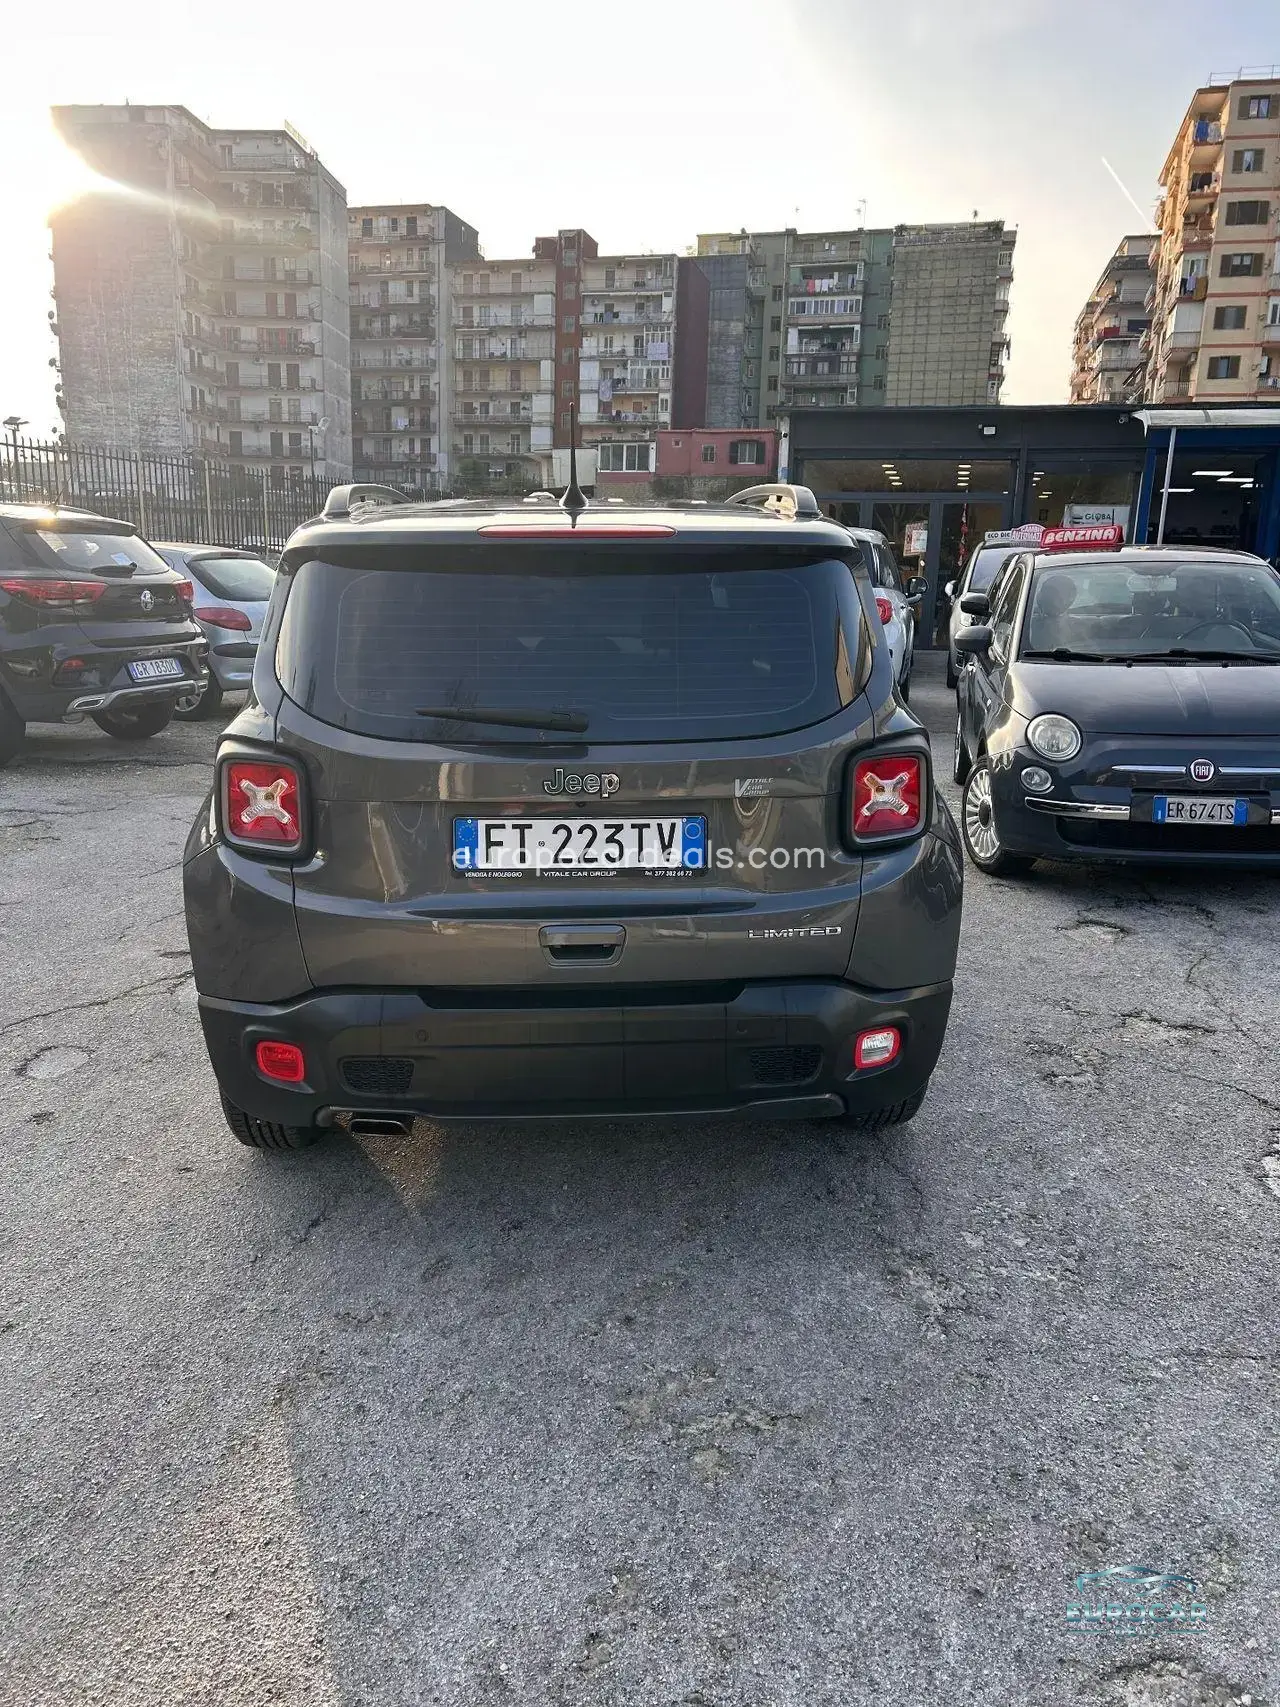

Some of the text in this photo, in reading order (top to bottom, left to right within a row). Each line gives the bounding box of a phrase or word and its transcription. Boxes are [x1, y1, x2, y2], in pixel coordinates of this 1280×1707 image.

[1045, 528, 1115, 544] BENZINA
[1195, 765, 1210, 776] FIAT
[543, 768, 620, 798] Jeep
[1168, 802, 1235, 820] ER 674TS
[484, 823, 676, 864] FT 223TV
[749, 926, 842, 938] LIMITED
